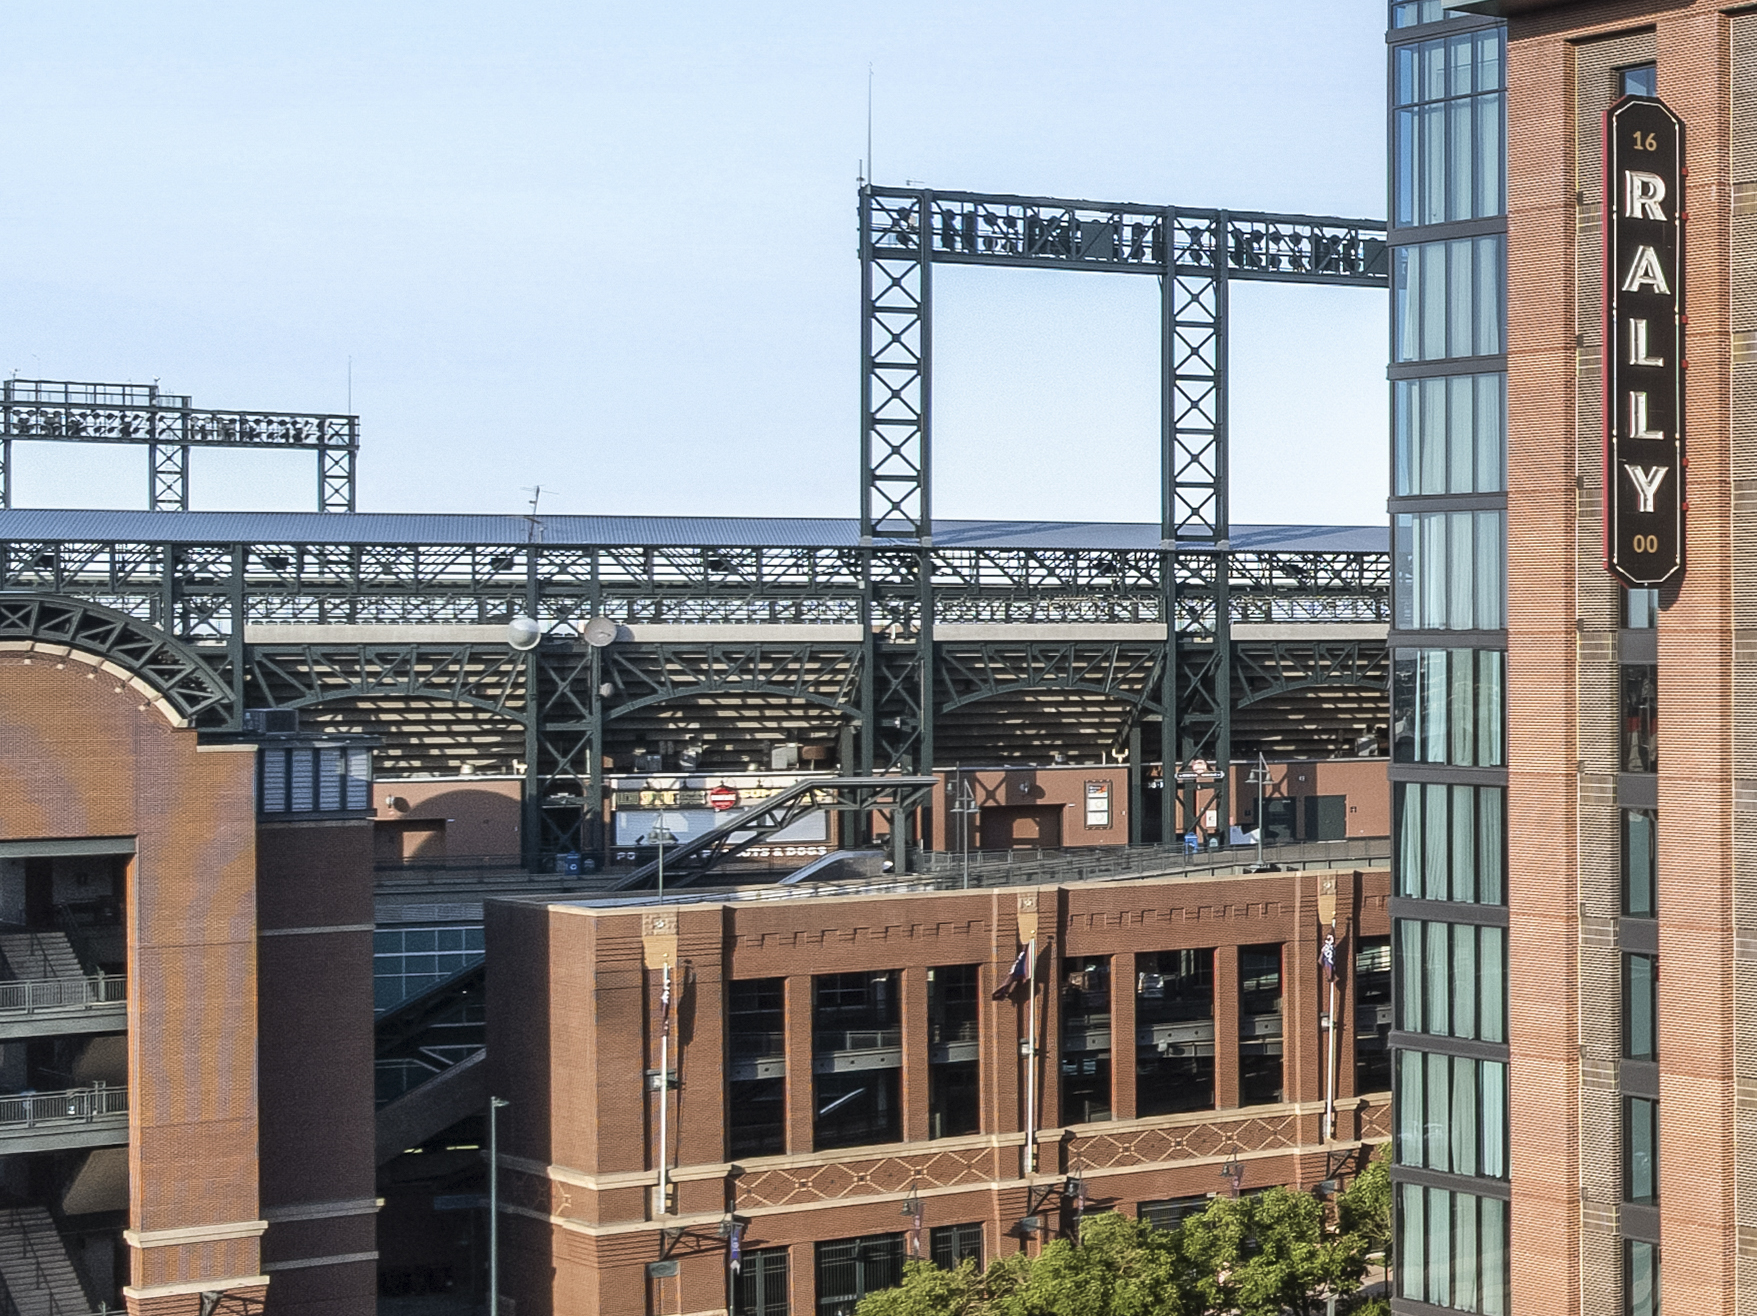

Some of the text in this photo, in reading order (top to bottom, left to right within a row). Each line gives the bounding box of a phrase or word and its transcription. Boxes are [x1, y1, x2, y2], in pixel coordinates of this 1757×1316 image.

[1633, 131, 1657, 152] 16
[1621, 168, 1671, 514] RALLY
[1633, 535, 1658, 554] 00
